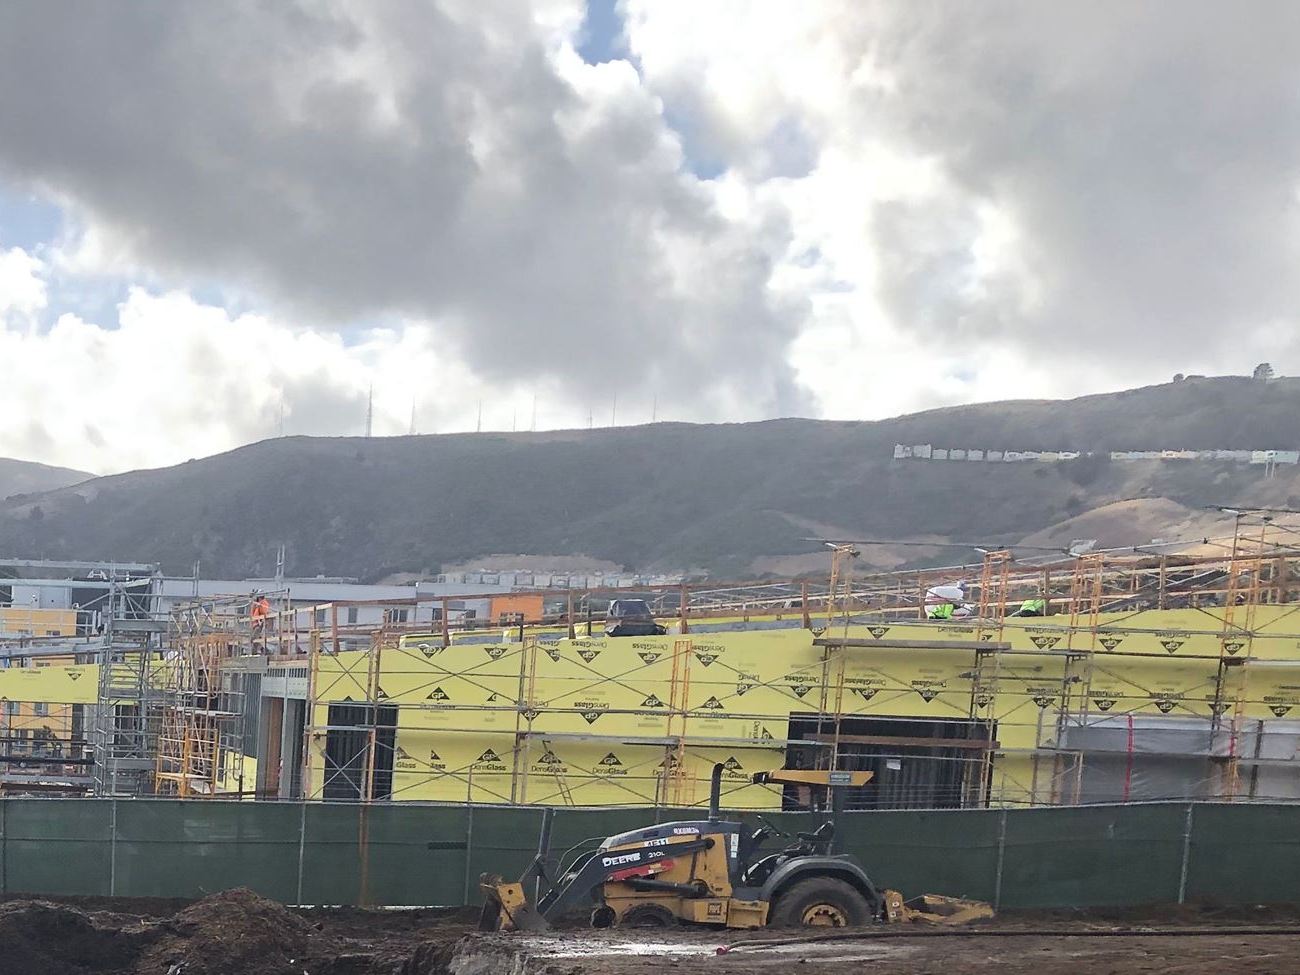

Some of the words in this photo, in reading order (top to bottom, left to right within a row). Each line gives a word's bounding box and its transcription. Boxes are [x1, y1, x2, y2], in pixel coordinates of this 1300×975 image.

[784, 675, 820, 683] DensGlass
[574, 701, 610, 709] DensGlass
[592, 767, 628, 775] DensGlass
[602, 852, 641, 867] DEERE
